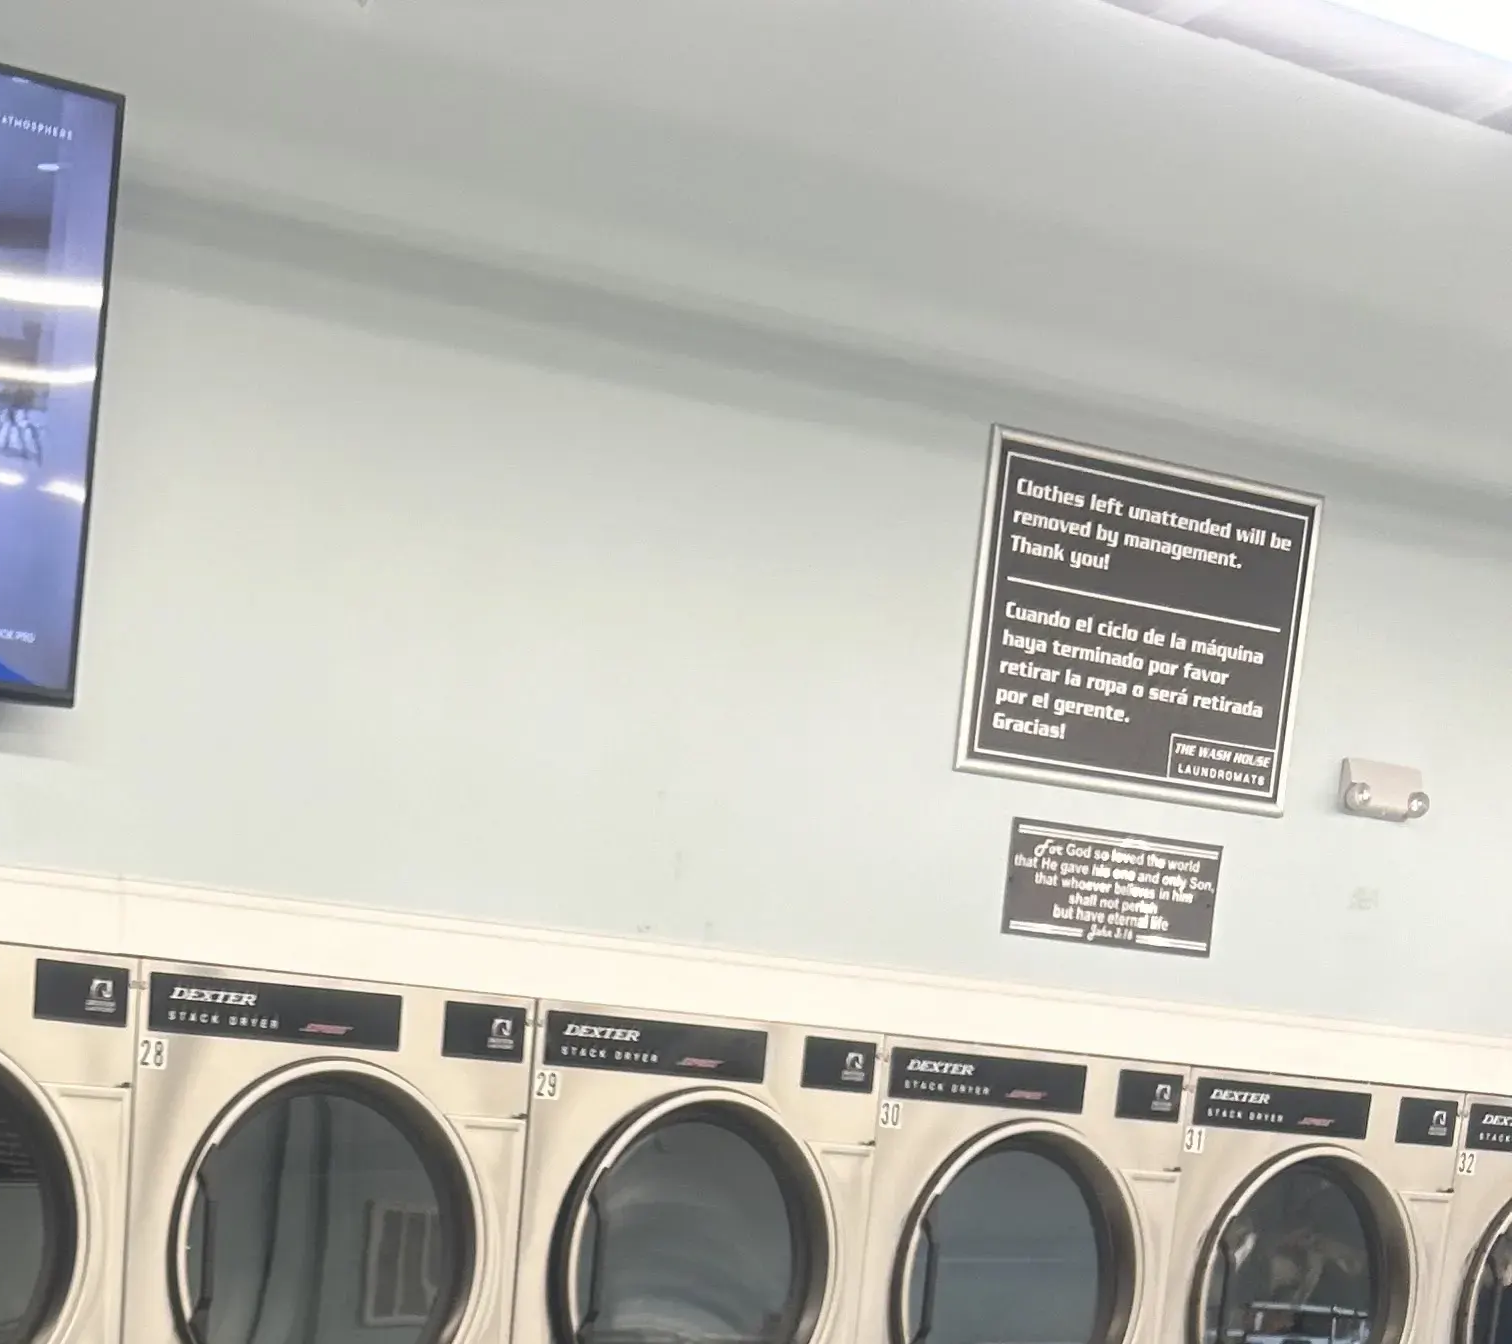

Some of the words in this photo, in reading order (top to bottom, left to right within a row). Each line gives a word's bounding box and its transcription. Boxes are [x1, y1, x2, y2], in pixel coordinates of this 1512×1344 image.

[1, 114, 73, 141] ATMOSPHERE
[1016, 478, 1085, 508] Clothes
[1090, 494, 1123, 517] left
[1128, 505, 1232, 538] unattended
[1236, 528, 1266, 547] will
[1270, 532, 1292, 551] be
[1010, 534, 1065, 562] Thank
[1070, 551, 1110, 571] you!
[1013, 509, 1091, 538] removed
[1096, 524, 1119, 548] by
[1124, 532, 1242, 569] management.
[1005, 601, 1071, 630] Cuando
[1075, 616, 1093, 634] el
[1097, 620, 1138, 643] ciclo
[1143, 628, 1165, 647] de
[1170, 632, 1186, 651] la
[1191, 638, 1264, 665] máquina
[1002, 629, 1047, 655] haya
[1052, 639, 1144, 671] terminado
[1148, 658, 1179, 677] por
[1183, 662, 1230, 686] favor
[999, 658, 1060, 684] retirar
[1065, 669, 1082, 688] la
[1087, 675, 1128, 698] ropa
[1132, 682, 1144, 698] o
[1148, 687, 1188, 706] será
[1192, 693, 1263, 719] retirada
[995, 687, 1027, 706] por
[1032, 692, 1050, 710] el
[1053, 698, 1130, 724] gerente.
[992, 712, 1067, 740] Gracias!
[1174, 743, 1197, 757] THE
[1198, 746, 1232, 762] WASH
[1233, 752, 1272, 768] HOUSE
[1177, 763, 1265, 786] LAUNDROMATS
[1065, 843, 1092, 859] God
[1094, 850, 1110, 862] so
[1111, 848, 1145, 866] loved
[1146, 853, 1166, 869] the
[1167, 859, 1201, 874] world
[1014, 853, 1038, 869] that
[1041, 857, 1058, 871] He
[1060, 861, 1089, 876] gave
[1091, 863, 1111, 879] his
[1112, 867, 1136, 882] one
[1137, 869, 1160, 885] and
[1161, 874, 1187, 890] only
[1189, 876, 1215, 894] Son,
[1034, 872, 1059, 887] that
[1061, 876, 1113, 894] whoever
[1114, 881, 1156, 899] believes
[1159, 886, 1171, 901] in
[1171, 889, 1194, 904] him
[1068, 892, 1098, 906] shall
[1099, 897, 1120, 911] not
[1121, 899, 1159, 915] perish
[1052, 904, 1075, 920] but
[1075, 908, 1106, 924] have
[1107, 911, 1149, 930] eternal
[1150, 916, 1169, 932] life
[169, 986, 258, 1007] DEXTER
[168, 1010, 220, 1024] STACK
[562, 1022, 640, 1042] DEXTER
[140, 1039, 164, 1067] 28
[906, 1058, 976, 1077] DEXTER
[536, 1072, 558, 1097] 29
[1209, 1088, 1271, 1105] DEXTER
[880, 1102, 900, 1126] 30
[1185, 1128, 1203, 1151] 31
[1458, 1152, 1476, 1175] 32
